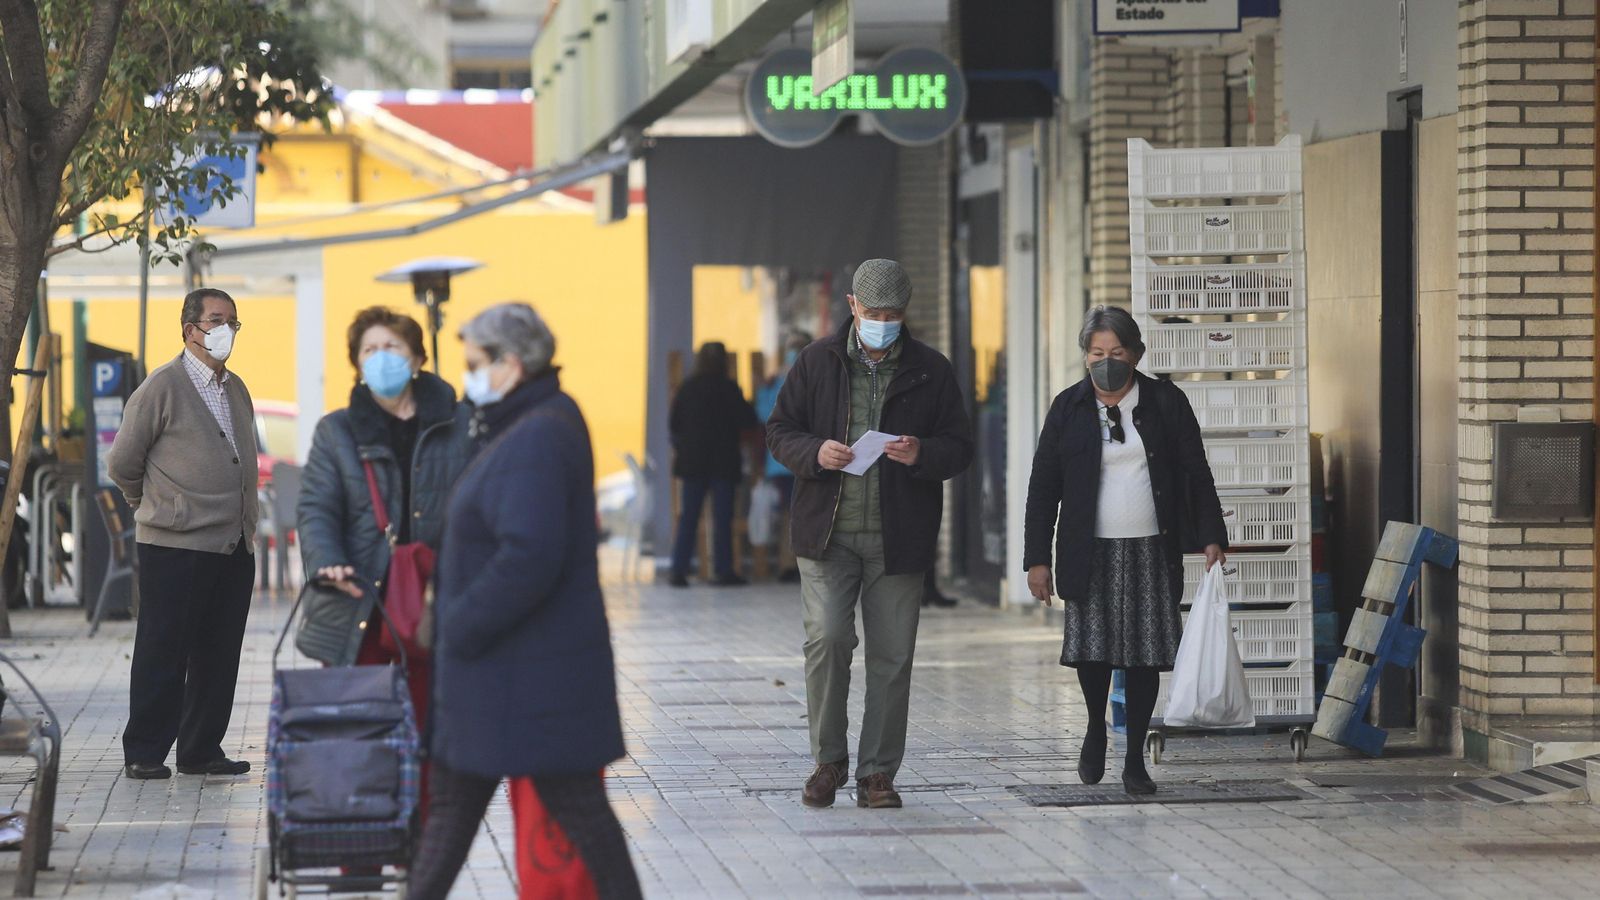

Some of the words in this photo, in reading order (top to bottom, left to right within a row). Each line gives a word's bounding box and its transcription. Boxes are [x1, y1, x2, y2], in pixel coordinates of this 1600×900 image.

[1116, 6, 1164, 20] Estado
[767, 74, 947, 110] VARILUX
[96, 362, 114, 392] P
